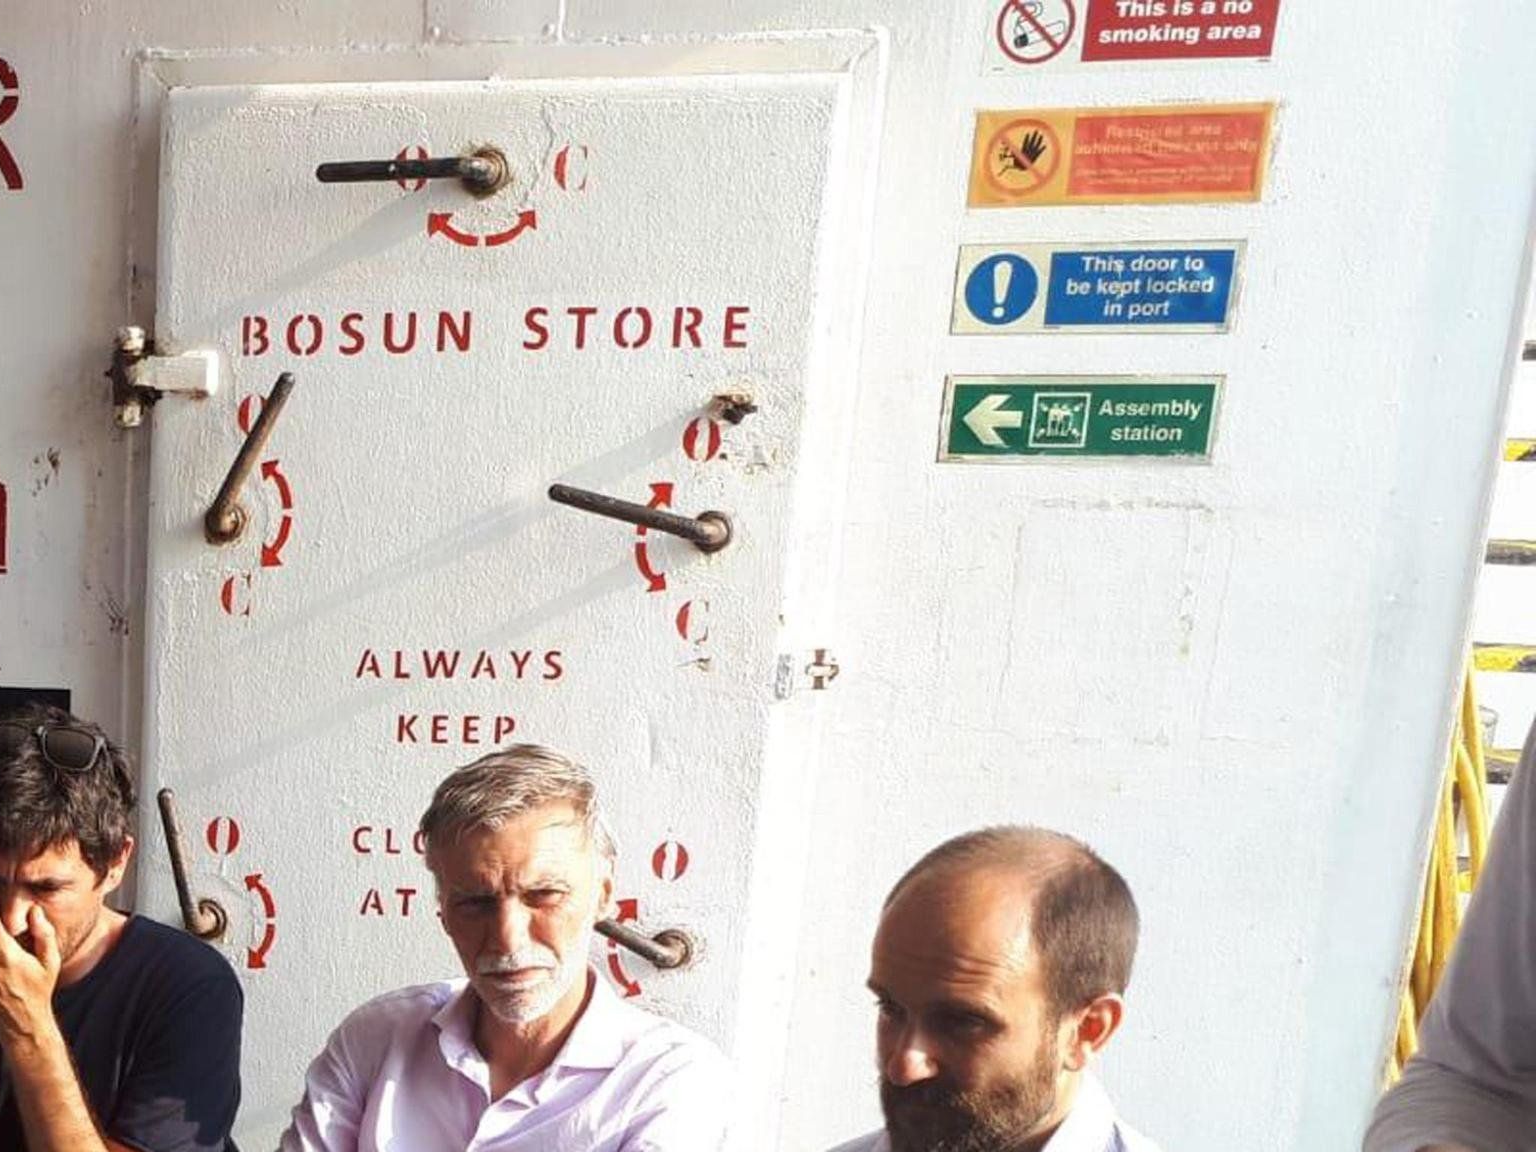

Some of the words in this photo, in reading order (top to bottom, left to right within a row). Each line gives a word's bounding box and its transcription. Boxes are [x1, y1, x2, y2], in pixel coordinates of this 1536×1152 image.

[1116, 0, 1167, 17] This
[1173, 0, 1194, 15] is
[1201, 2, 1216, 14] a
[1223, 0, 1253, 14] no
[1098, 23, 1201, 45] smoking
[1207, 25, 1261, 40] area
[1082, 255, 1125, 272] This
[1131, 255, 1179, 271] door
[1184, 256, 1205, 270] to
[1066, 278, 1091, 295] be
[1097, 278, 1142, 298] kept
[1146, 276, 1215, 293] locked
[1103, 300, 1123, 316] in
[1128, 301, 1171, 319] port
[242, 311, 471, 356] BOSUN
[523, 307, 751, 349] STORE
[1098, 399, 1202, 420] Assembly
[1110, 425, 1183, 441] station
[356, 649, 563, 680] ALWAYS
[397, 715, 516, 744] KEEP
[360, 888, 417, 917] AT
